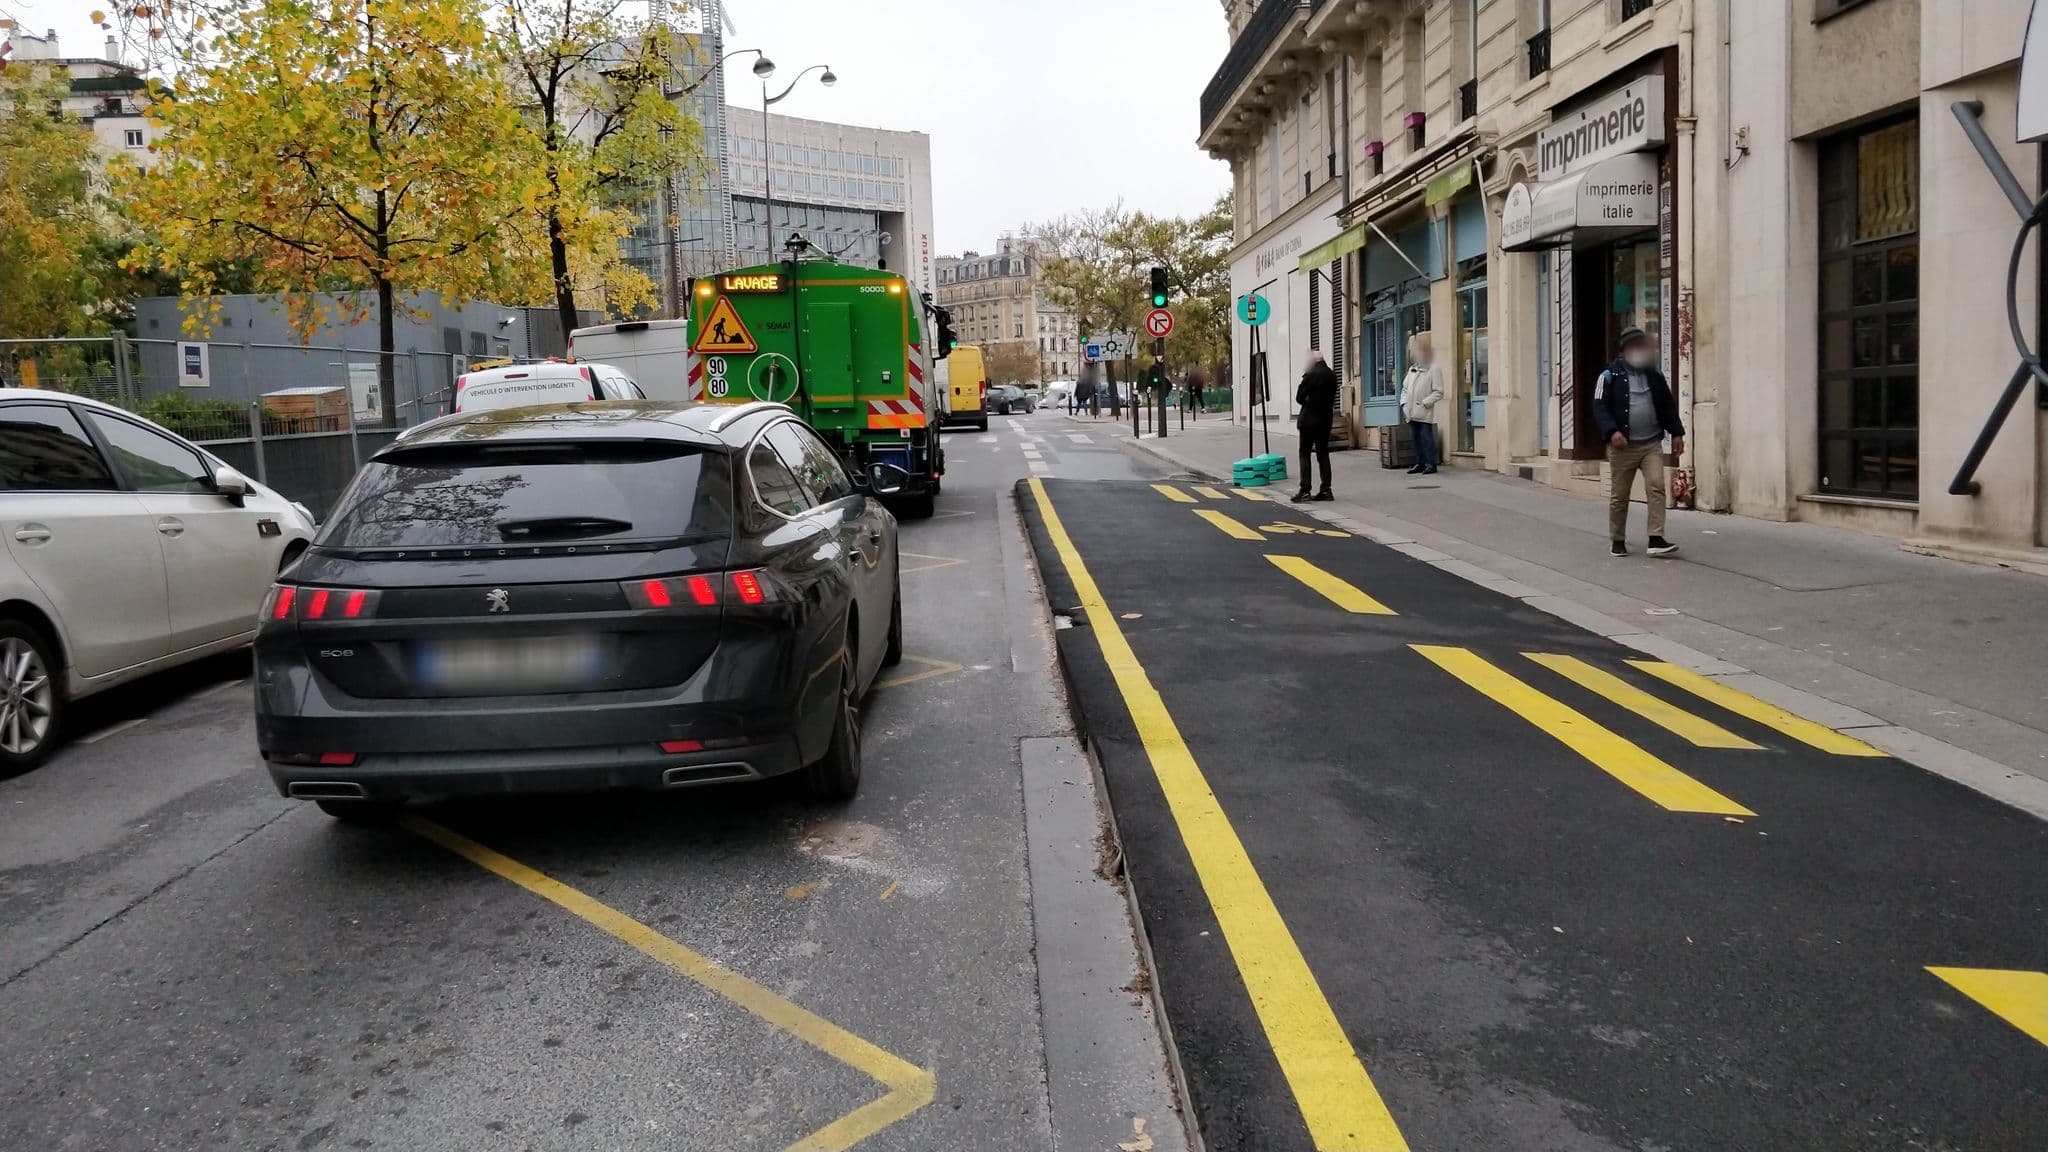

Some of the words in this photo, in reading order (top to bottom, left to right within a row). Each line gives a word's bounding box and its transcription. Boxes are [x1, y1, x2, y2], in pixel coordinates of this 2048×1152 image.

[1540, 89, 1645, 174] imprimerie
[1585, 179, 1653, 199] imprimerie
[1602, 203, 1633, 218] italie
[725, 276, 778, 290] LAVAGE
[709, 358, 725, 375] 90
[547, 382, 575, 390] URGENTE
[711, 379, 726, 395] 80
[320, 649, 354, 658] 508
